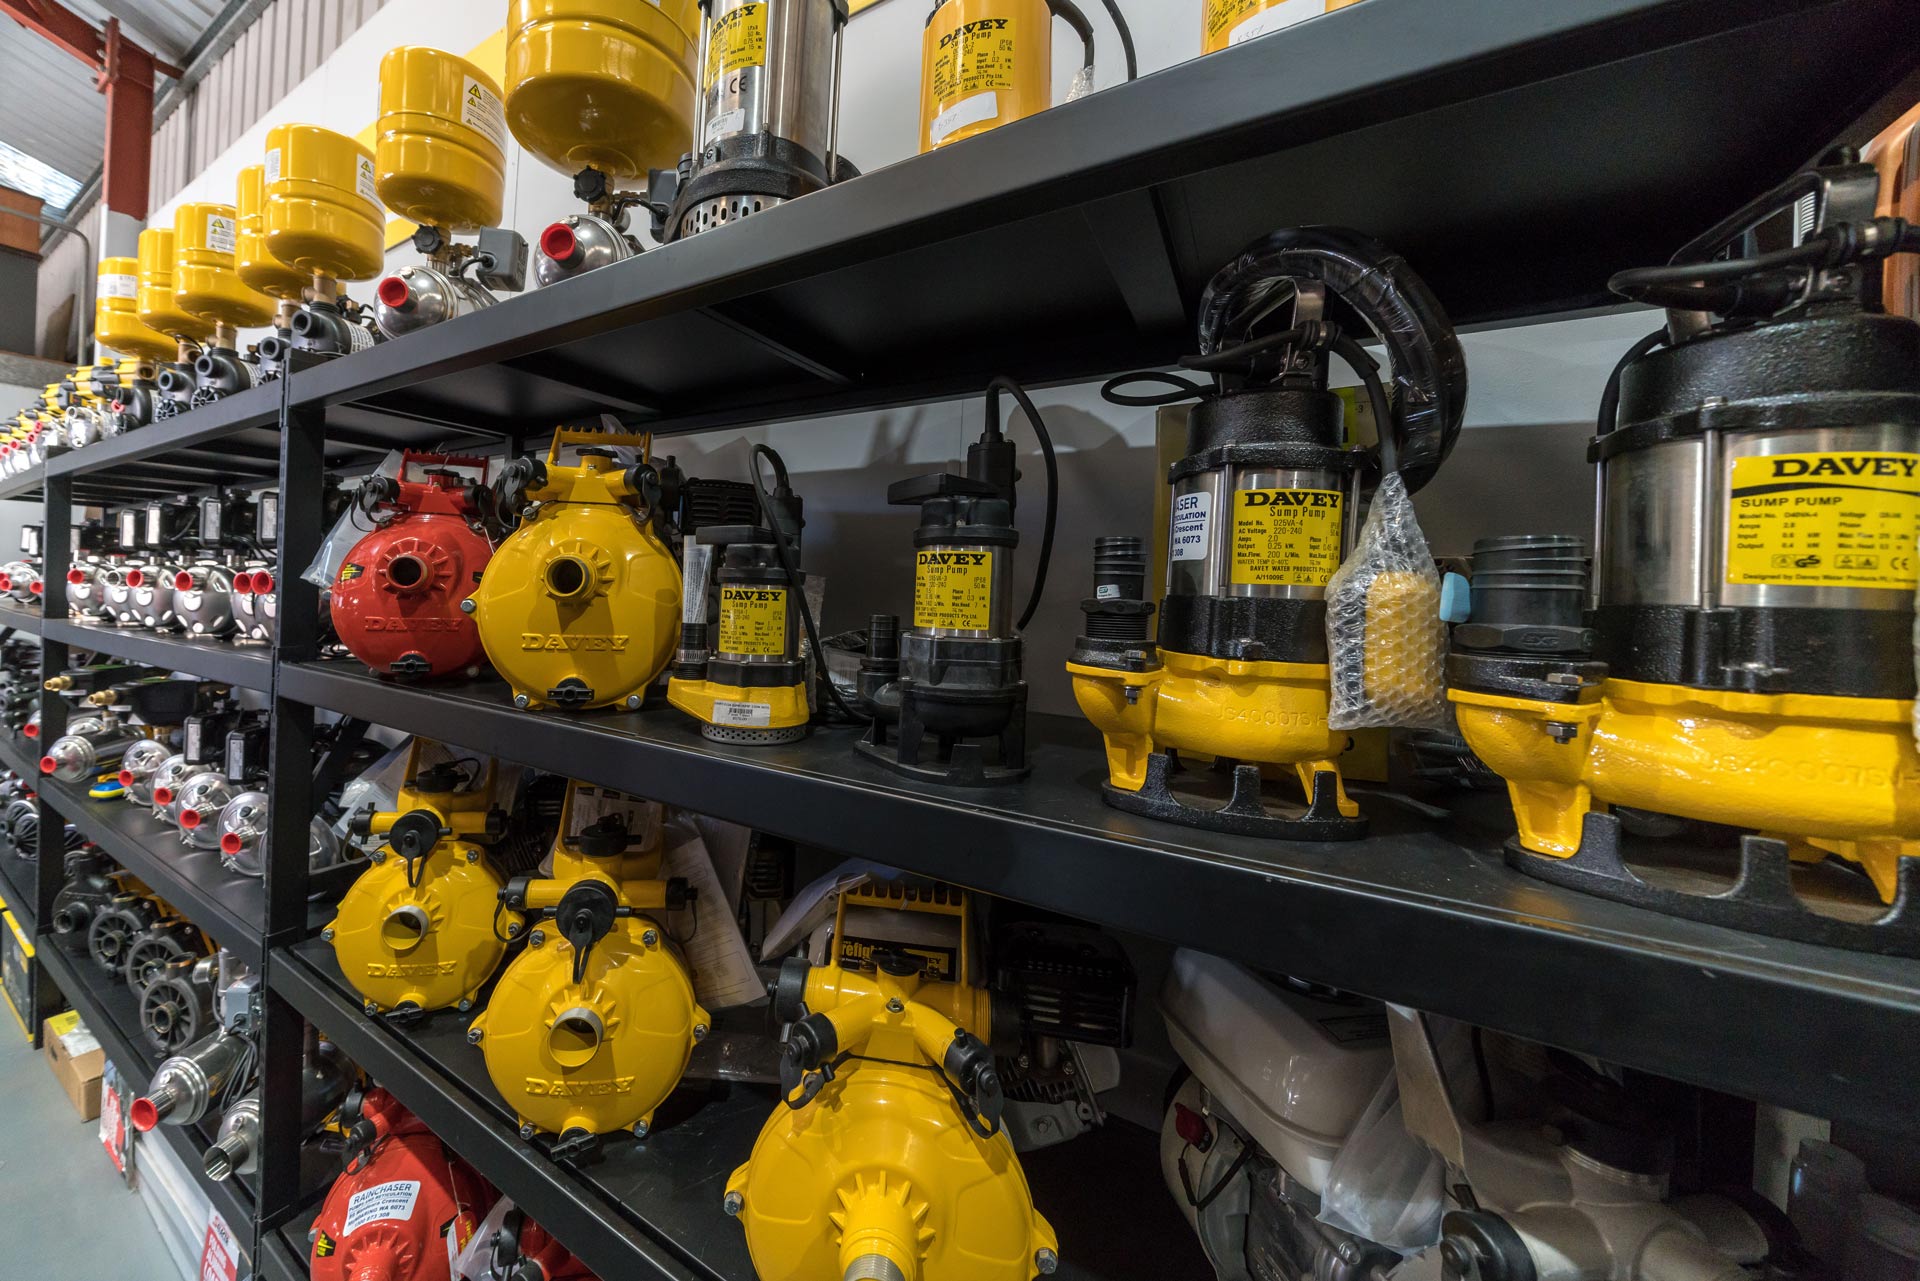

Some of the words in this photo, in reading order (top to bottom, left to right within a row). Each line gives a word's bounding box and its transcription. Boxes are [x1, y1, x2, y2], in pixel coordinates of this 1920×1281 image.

[940, 19, 1008, 50] DAVEY
[971, 32, 992, 40] Pump
[1772, 458, 1918, 478] DAVEY
[1244, 492, 1340, 508] DAVEY
[1740, 498, 1789, 508] SUMP
[1794, 496, 1842, 506] PUMP
[1270, 507, 1298, 518] Sump
[1302, 506, 1326, 520] Pump
[1182, 535, 1200, 544] 6073
[919, 554, 986, 566] DAVEY
[928, 565, 944, 574] Sump
[946, 565, 968, 576] Pump
[724, 590, 782, 602] DAVEY
[732, 600, 748, 609] Sump
[750, 601, 768, 610] Pump
[364, 616, 463, 632] DAVEY
[522, 633, 628, 651] DAVEY
[368, 960, 457, 977] DAVEY
[526, 1076, 636, 1096] DAVEY
[354, 1184, 412, 1204] RAINCHASER
